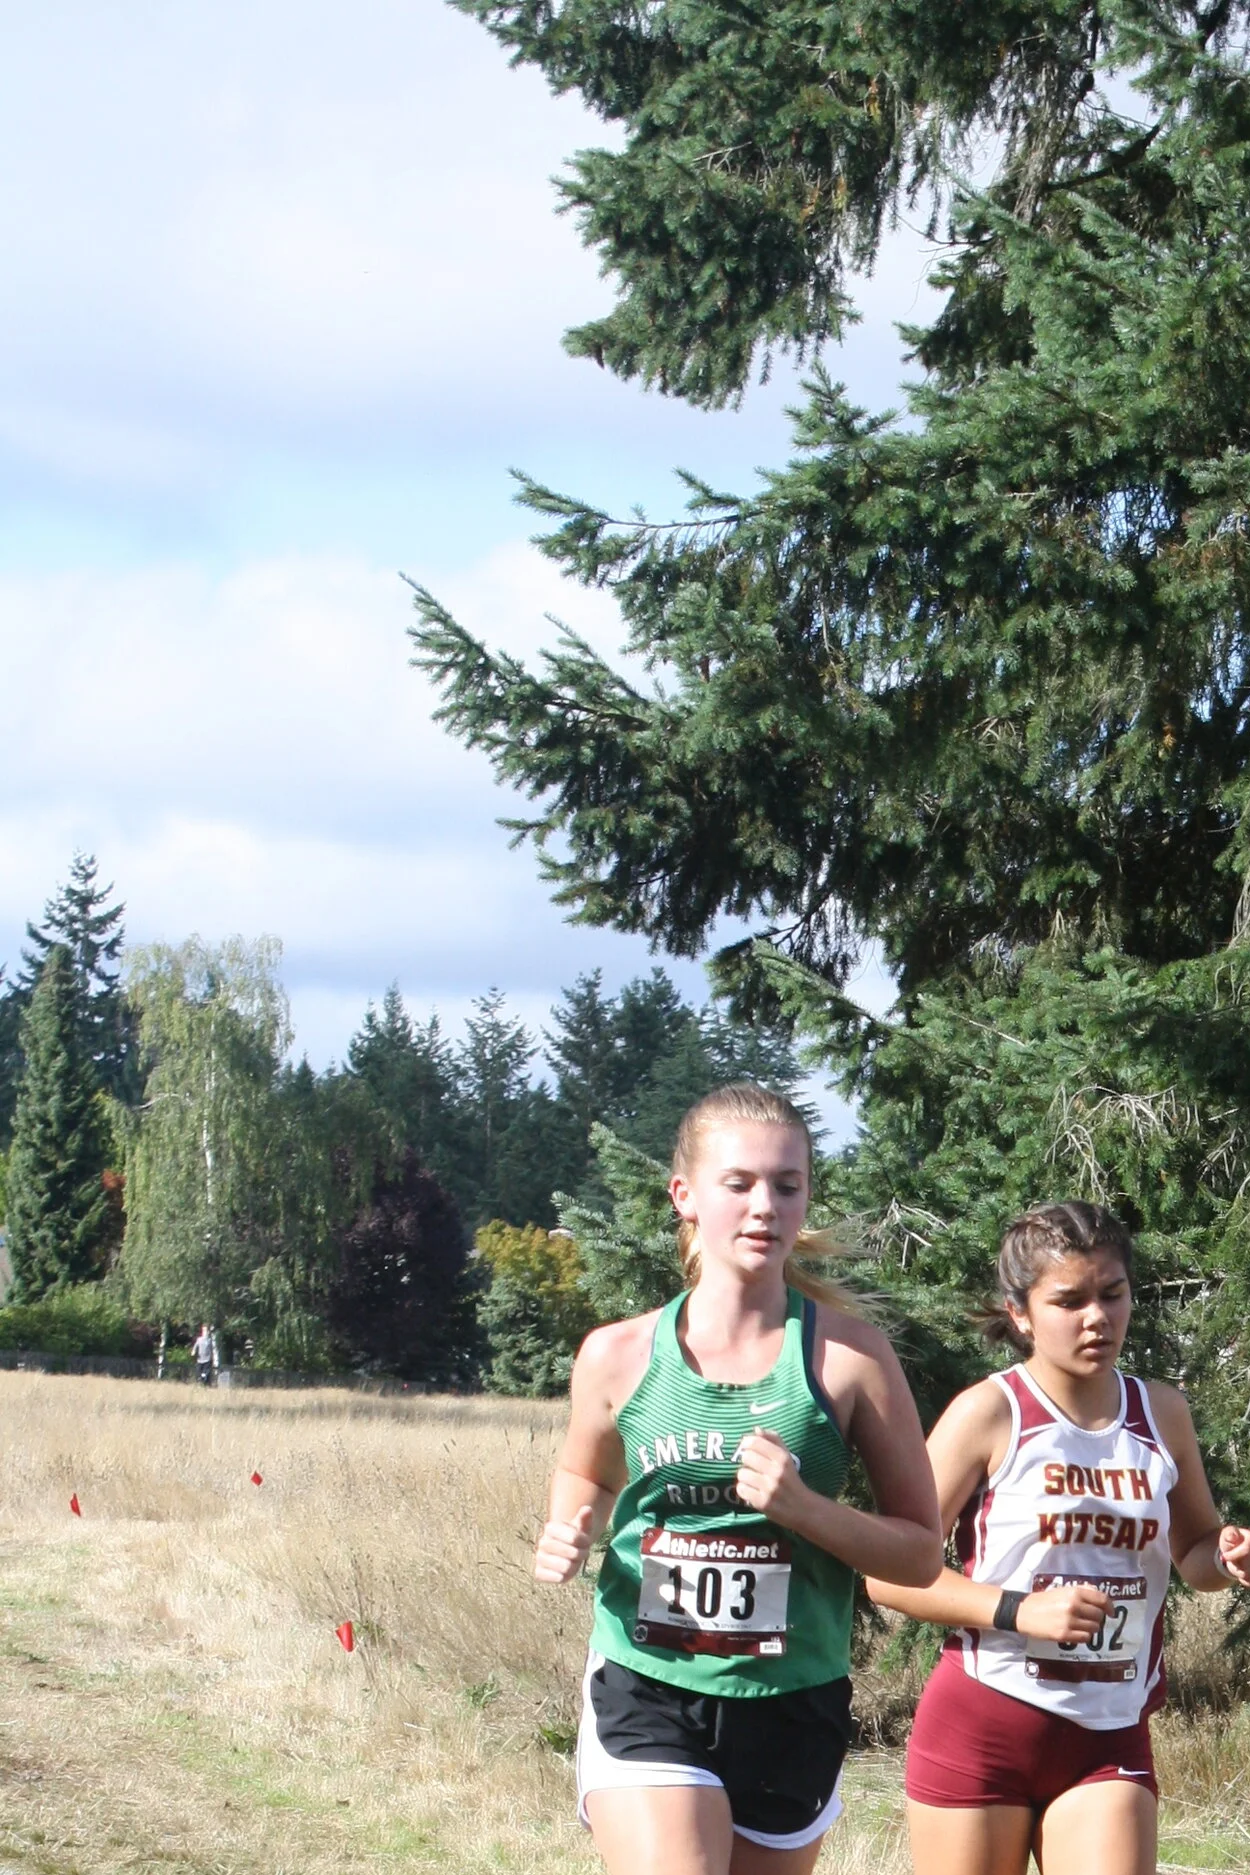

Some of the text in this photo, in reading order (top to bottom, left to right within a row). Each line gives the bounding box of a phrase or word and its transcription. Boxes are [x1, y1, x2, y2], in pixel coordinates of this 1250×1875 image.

[637, 1431, 801, 1475] EMERA
[666, 1483, 753, 1506] RIDG
[1044, 1463, 1153, 1501] SOUTH
[650, 1530, 779, 1559] Athletic.net
[1037, 1512, 1160, 1552] KITSAP
[667, 1565, 756, 1621] 103
[1044, 1575, 1143, 1597] Atic.net
[1058, 1605, 1128, 1652] 02
